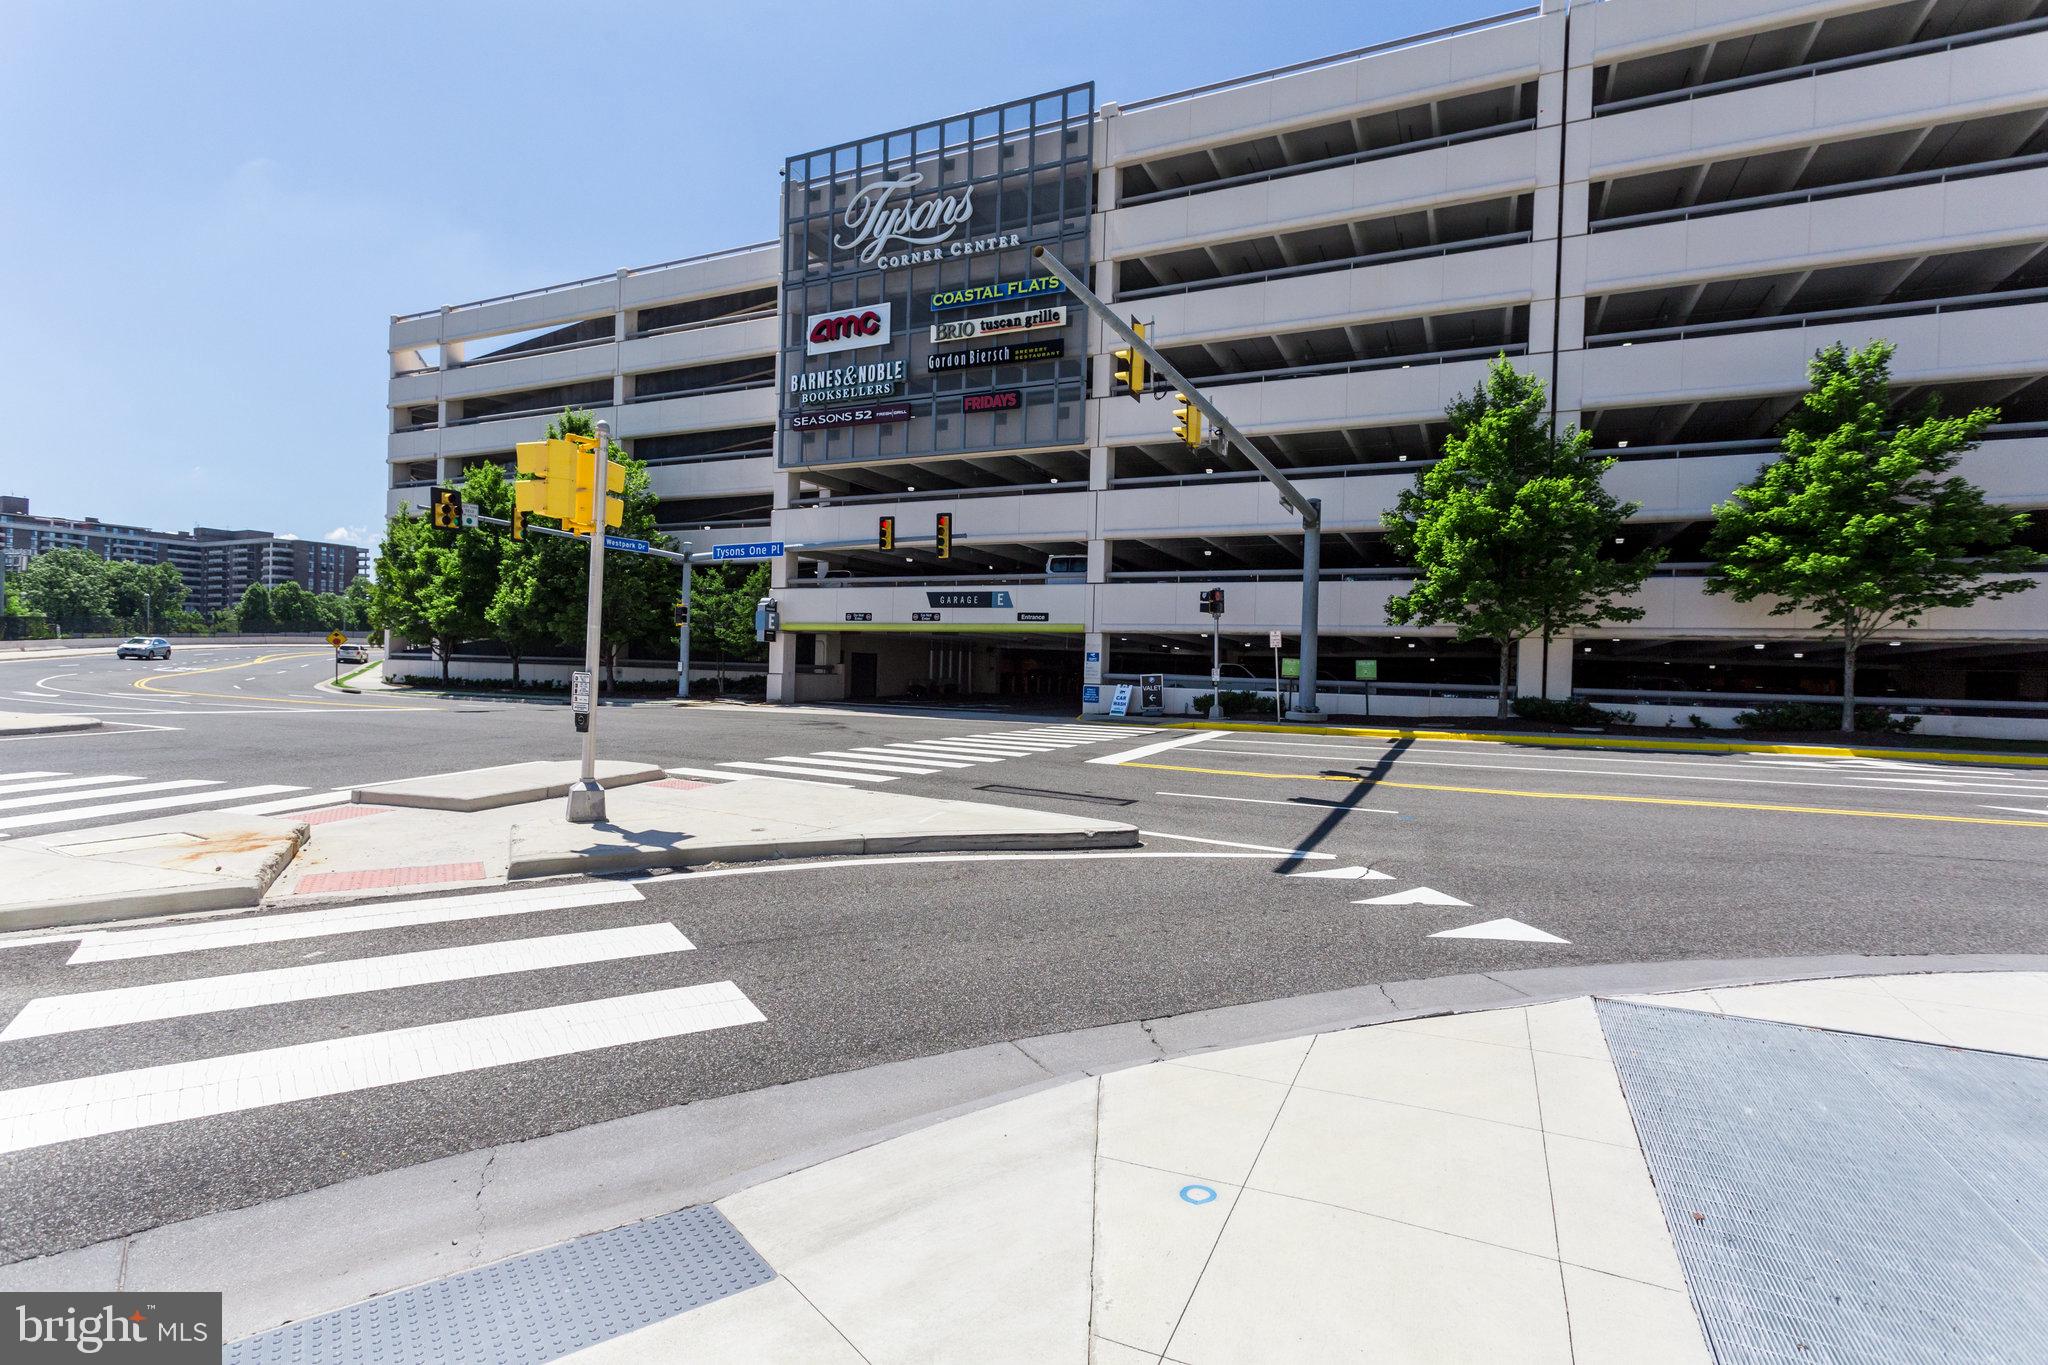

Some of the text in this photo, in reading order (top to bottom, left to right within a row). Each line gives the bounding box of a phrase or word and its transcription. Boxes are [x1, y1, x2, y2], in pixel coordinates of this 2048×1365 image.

[834, 172, 975, 263] Tysons
[877, 234, 1021, 270] CORNER CENTER
[932, 276, 1060, 307] COASTAL FLATS
[935, 309, 1061, 341] BRIO tuscan grille
[928, 346, 1010, 370] Gordon Biersch
[1014, 350, 1060, 361] RESTAURANT
[801, 383, 892, 403] BOOKSELLERS
[964, 393, 1017, 411] FRIDAYS
[793, 410, 873, 428] SEASONS 52
[606, 537, 646, 550] Westpark Dr
[716, 545, 781, 558] Tysons One Pl
[939, 593, 1004, 606] GARAGE E
[768, 613, 776, 629] E
[1021, 613, 1046, 621] Entrance
